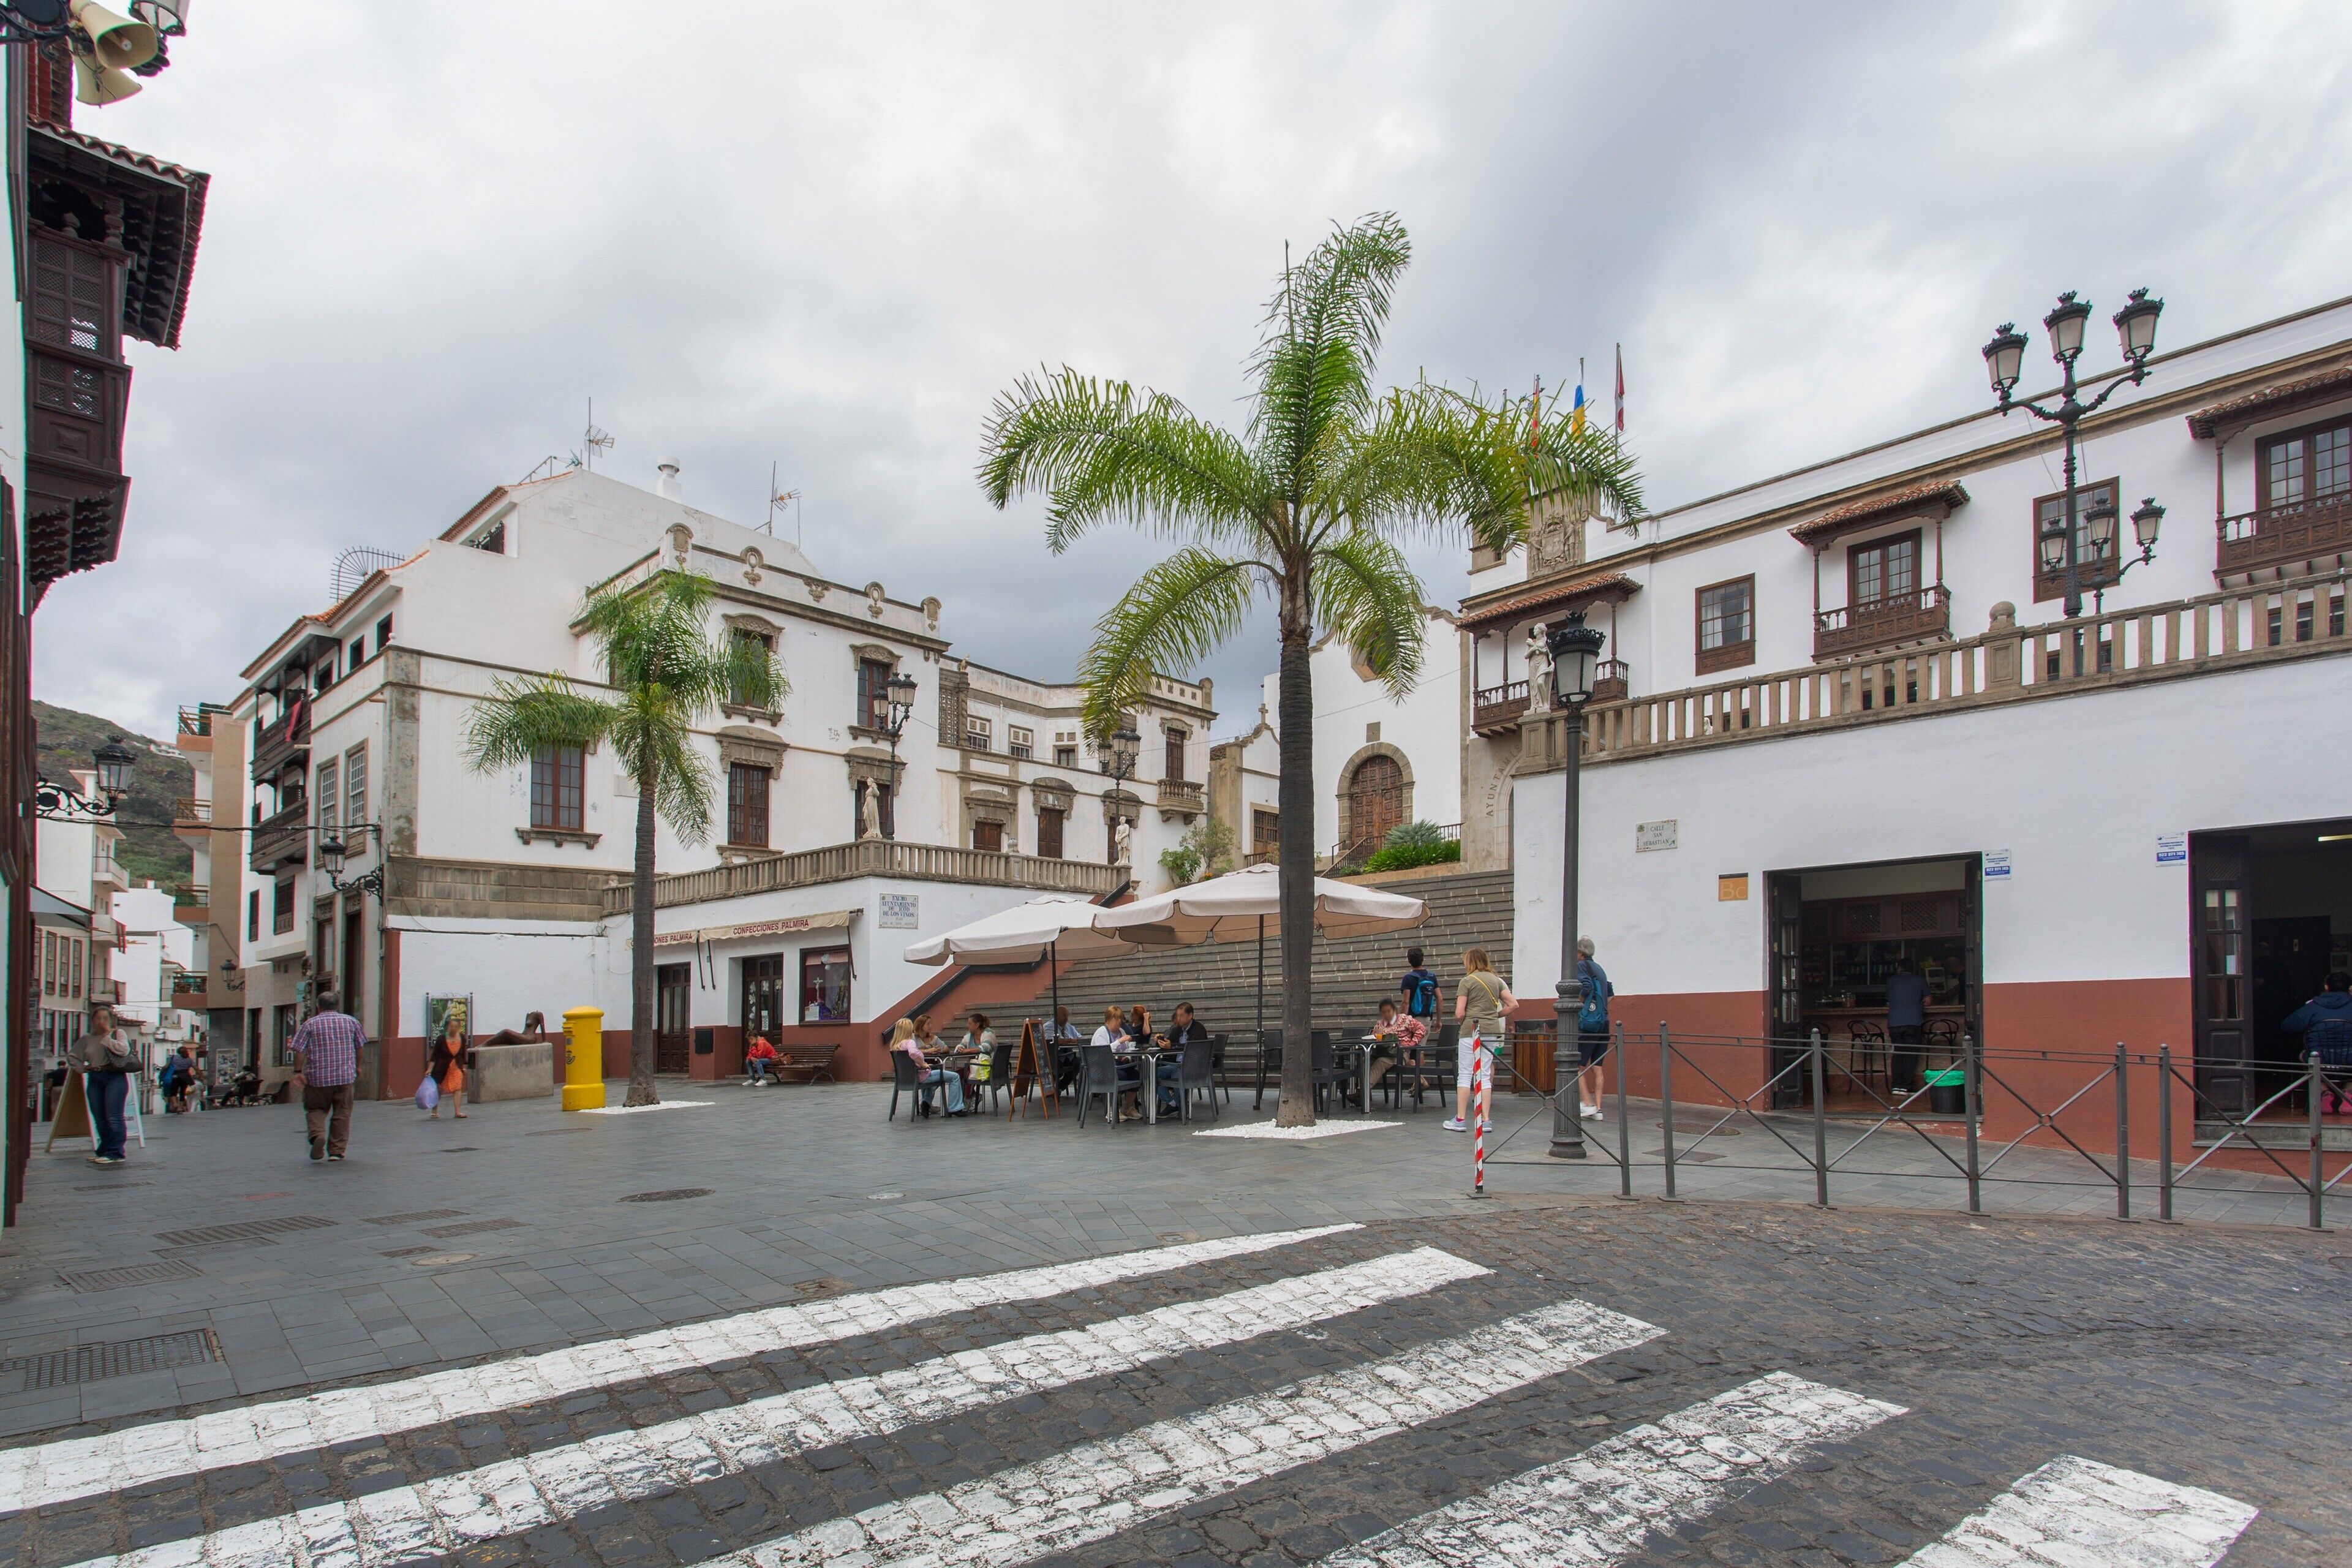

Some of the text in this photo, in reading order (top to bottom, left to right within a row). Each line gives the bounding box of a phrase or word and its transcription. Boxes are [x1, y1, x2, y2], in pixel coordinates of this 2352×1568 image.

[733, 919, 809, 935] CONFECCIONES PALMIRA
[670, 933, 693, 942] PALMIRA
